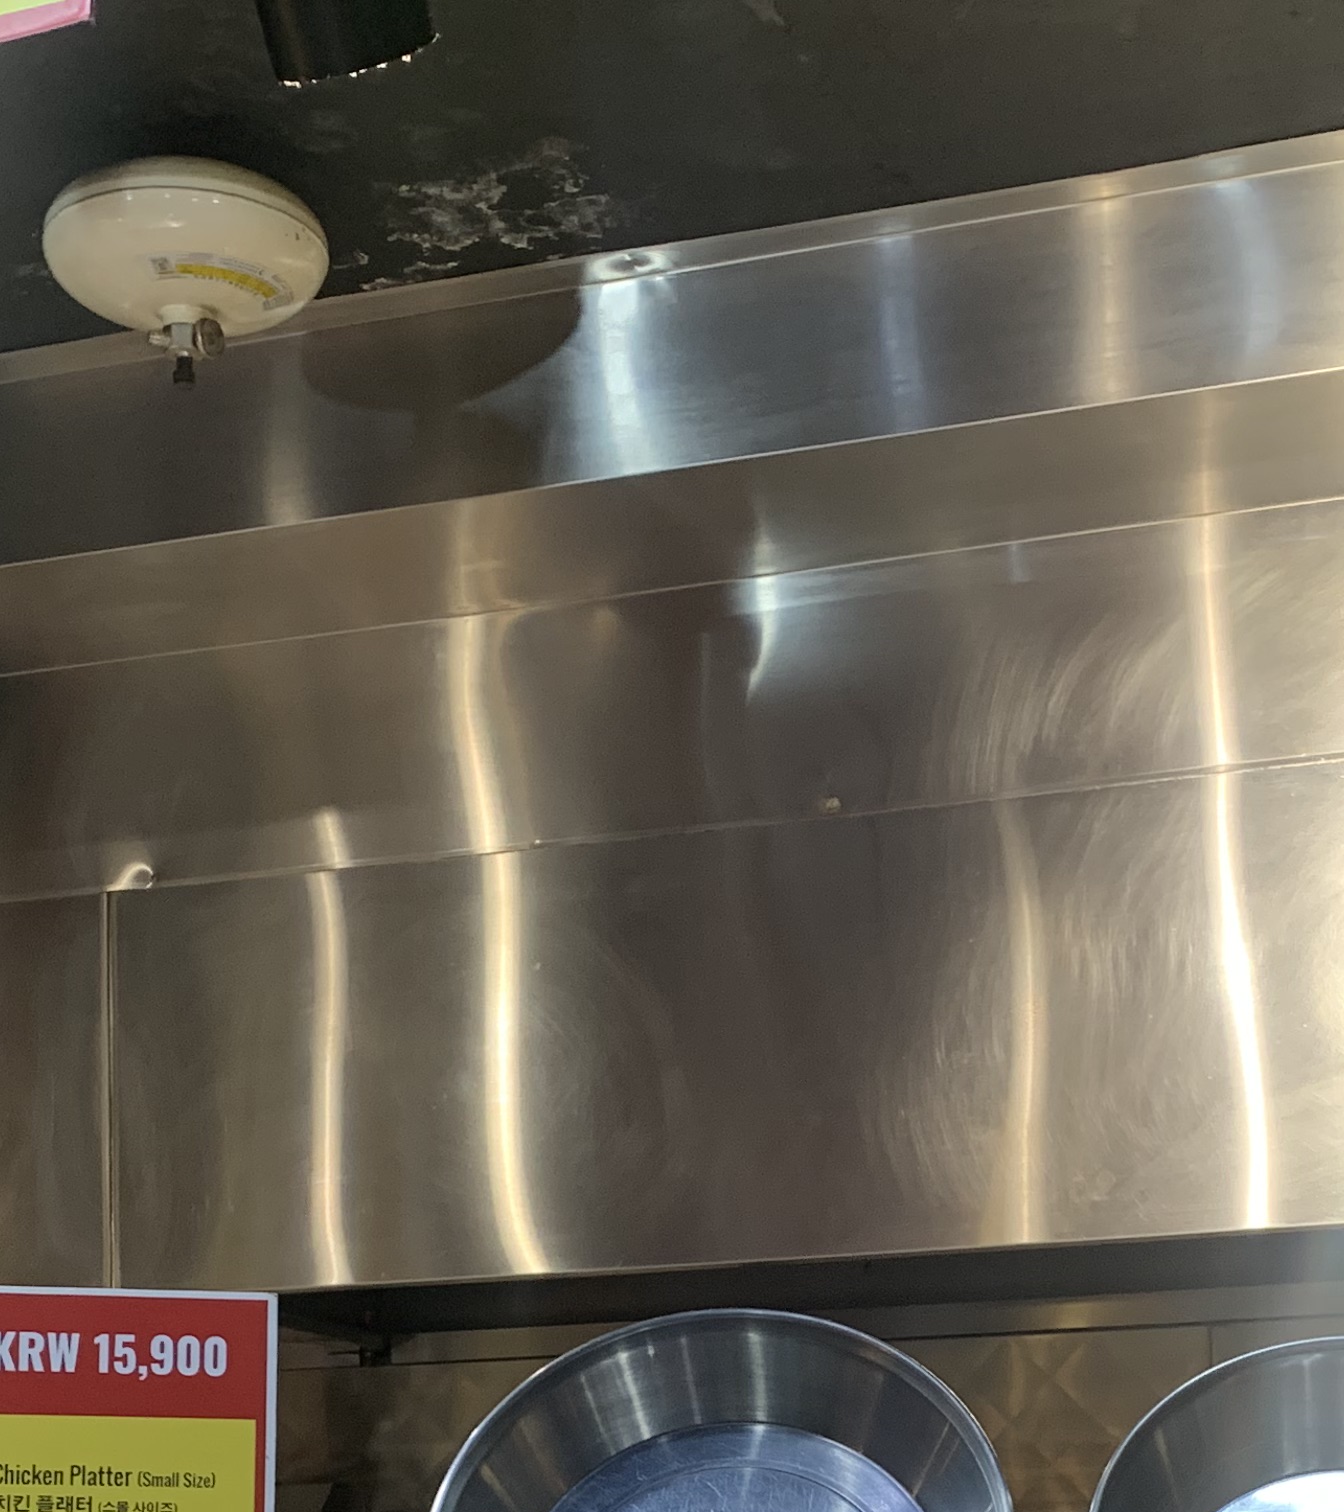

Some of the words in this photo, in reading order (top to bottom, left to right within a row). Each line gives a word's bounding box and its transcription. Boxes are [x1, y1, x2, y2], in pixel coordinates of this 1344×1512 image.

[93, 1332, 228, 1381] 15,900
[69, 1464, 133, 1488] Platter
[137, 1470, 180, 1489] (Small
[183, 1471, 217, 1490] Size)
